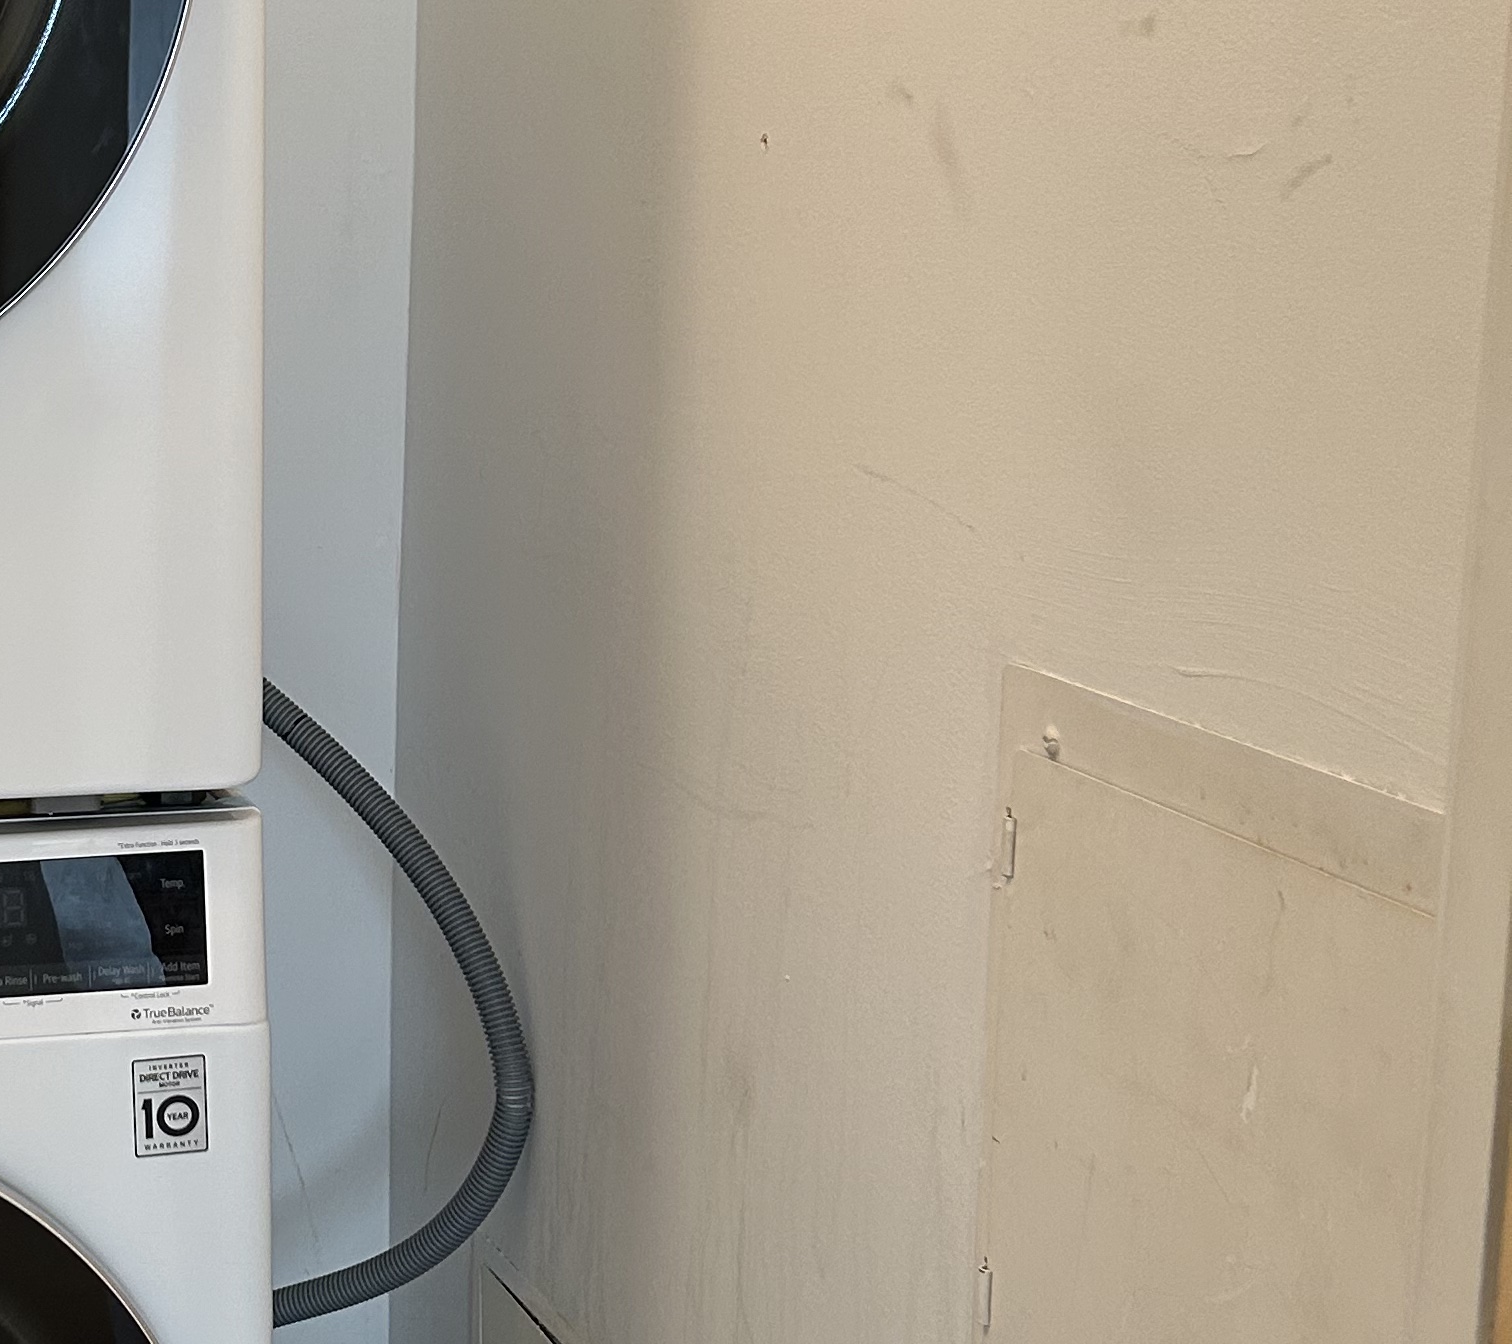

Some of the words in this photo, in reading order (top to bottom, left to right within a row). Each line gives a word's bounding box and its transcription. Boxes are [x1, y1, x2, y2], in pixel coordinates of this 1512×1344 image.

[165, 923, 184, 936] Spin
[5, 976, 28, 986] Rinse
[148, 1062, 189, 1071] INVERTER
[139, 1072, 170, 1082] DIRECT
[172, 1069, 199, 1080] DRIVE
[141, 1094, 200, 1139] 10
[167, 1112, 189, 1121] YEAR
[144, 1139, 199, 1151] WARRANTY
